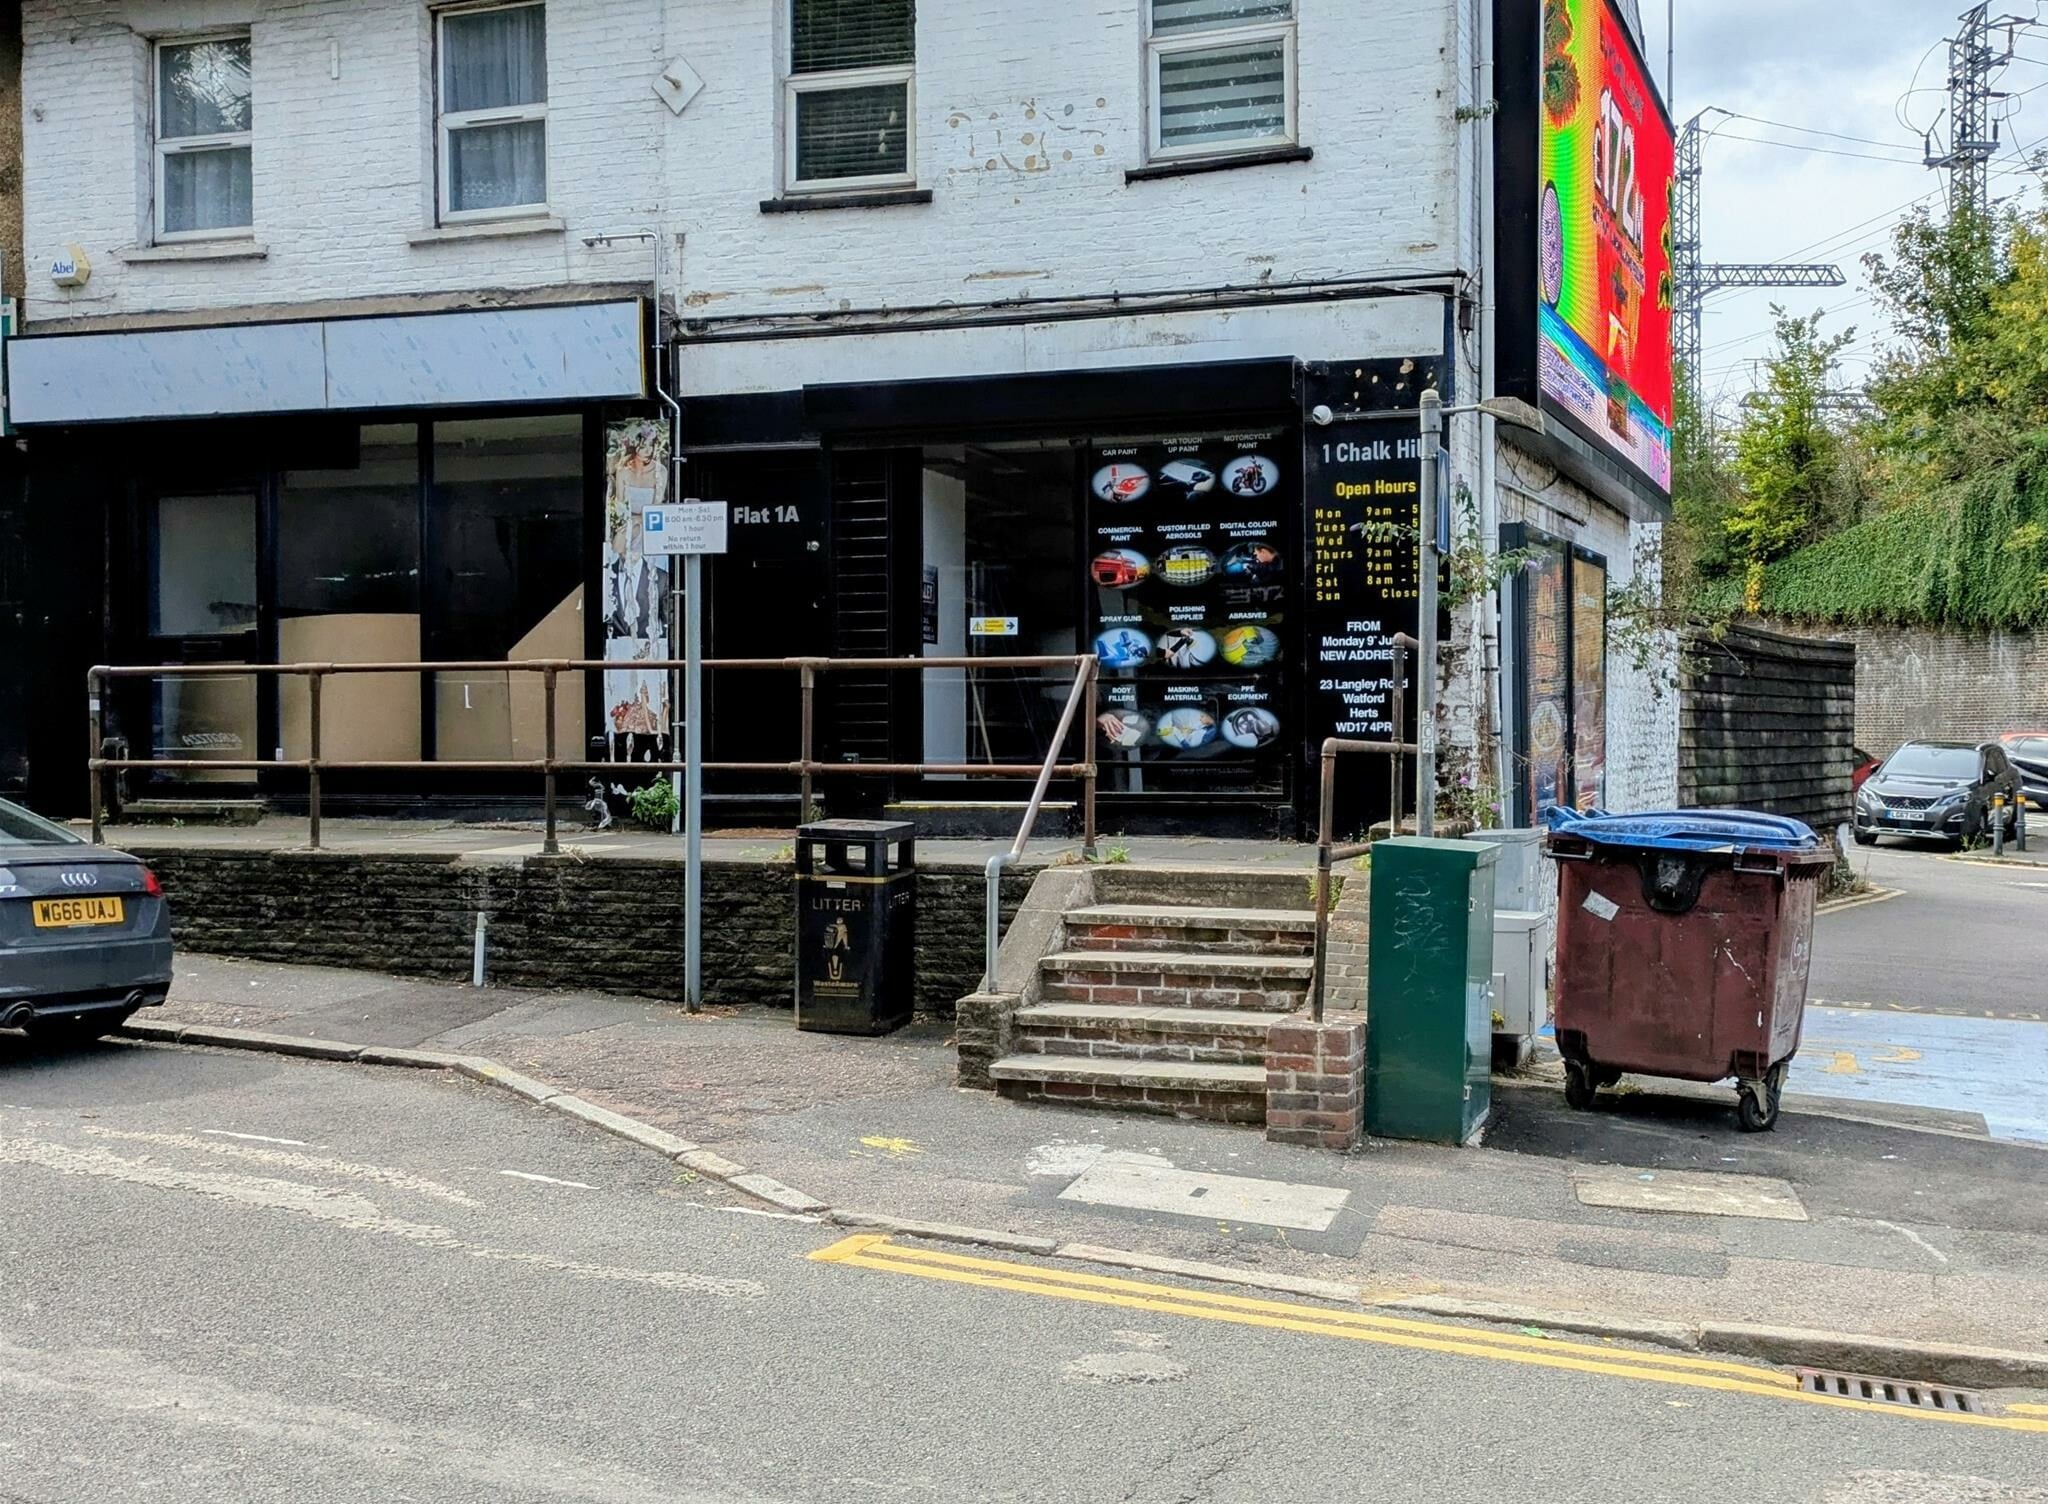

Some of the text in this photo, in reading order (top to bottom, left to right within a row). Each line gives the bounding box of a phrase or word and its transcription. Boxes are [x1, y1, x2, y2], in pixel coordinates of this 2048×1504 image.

[51, 261, 74, 275] Abel
[1162, 437, 1176, 445] CAR
[1223, 433, 1272, 442] MOTORCYCLE
[1178, 445, 1199, 453] PAINT
[1237, 442, 1258, 450] PAINT
[1322, 438, 1421, 463] 1 Chalk Hil
[1118, 448, 1137, 456] PAINT
[1336, 480, 1417, 500] Open Hours
[734, 505, 800, 524] Flat 1A
[1315, 509, 1342, 519] Mon
[1366, 506, 1392, 516] 9am
[1157, 523, 1211, 532] CUSTOM FILLED
[1220, 520, 1277, 529] DIGITAL COLOUR
[1315, 522, 1346, 533] Tues
[1097, 526, 1144, 534] COMMERCIAL
[1230, 529, 1267, 537] MATCHING
[1315, 535, 1343, 546] Wed
[1316, 549, 1353, 560] Thurs
[1366, 547, 1392, 558] 9am
[1315, 562, 1334, 574] Fri
[1366, 561, 1393, 572] 9am
[1316, 577, 1338, 587] Sat
[1367, 575, 1393, 585] 8am
[1316, 591, 1341, 601] Sun
[1381, 588, 1418, 598] Close
[1169, 605, 1206, 613] POLISHING
[1099, 615, 1122, 623] SPRAY
[1170, 613, 1204, 621] SUPPLIES
[1346, 620, 1381, 632] FROM
[1322, 636, 1365, 649] Monday
[1320, 649, 1408, 661] NEW ADDRES:
[1319, 678, 1409, 692] 23 Langley Rod
[1108, 694, 1135, 702] FILLERS
[1227, 693, 1268, 701] EQUIPMENT
[1342, 693, 1385, 704] Watford
[1349, 708, 1379, 718] Herts
[1335, 721, 1392, 733] WD17 4PR
[812, 898, 861, 912] LITTER
[40, 900, 117, 922] WG66 UAJ
